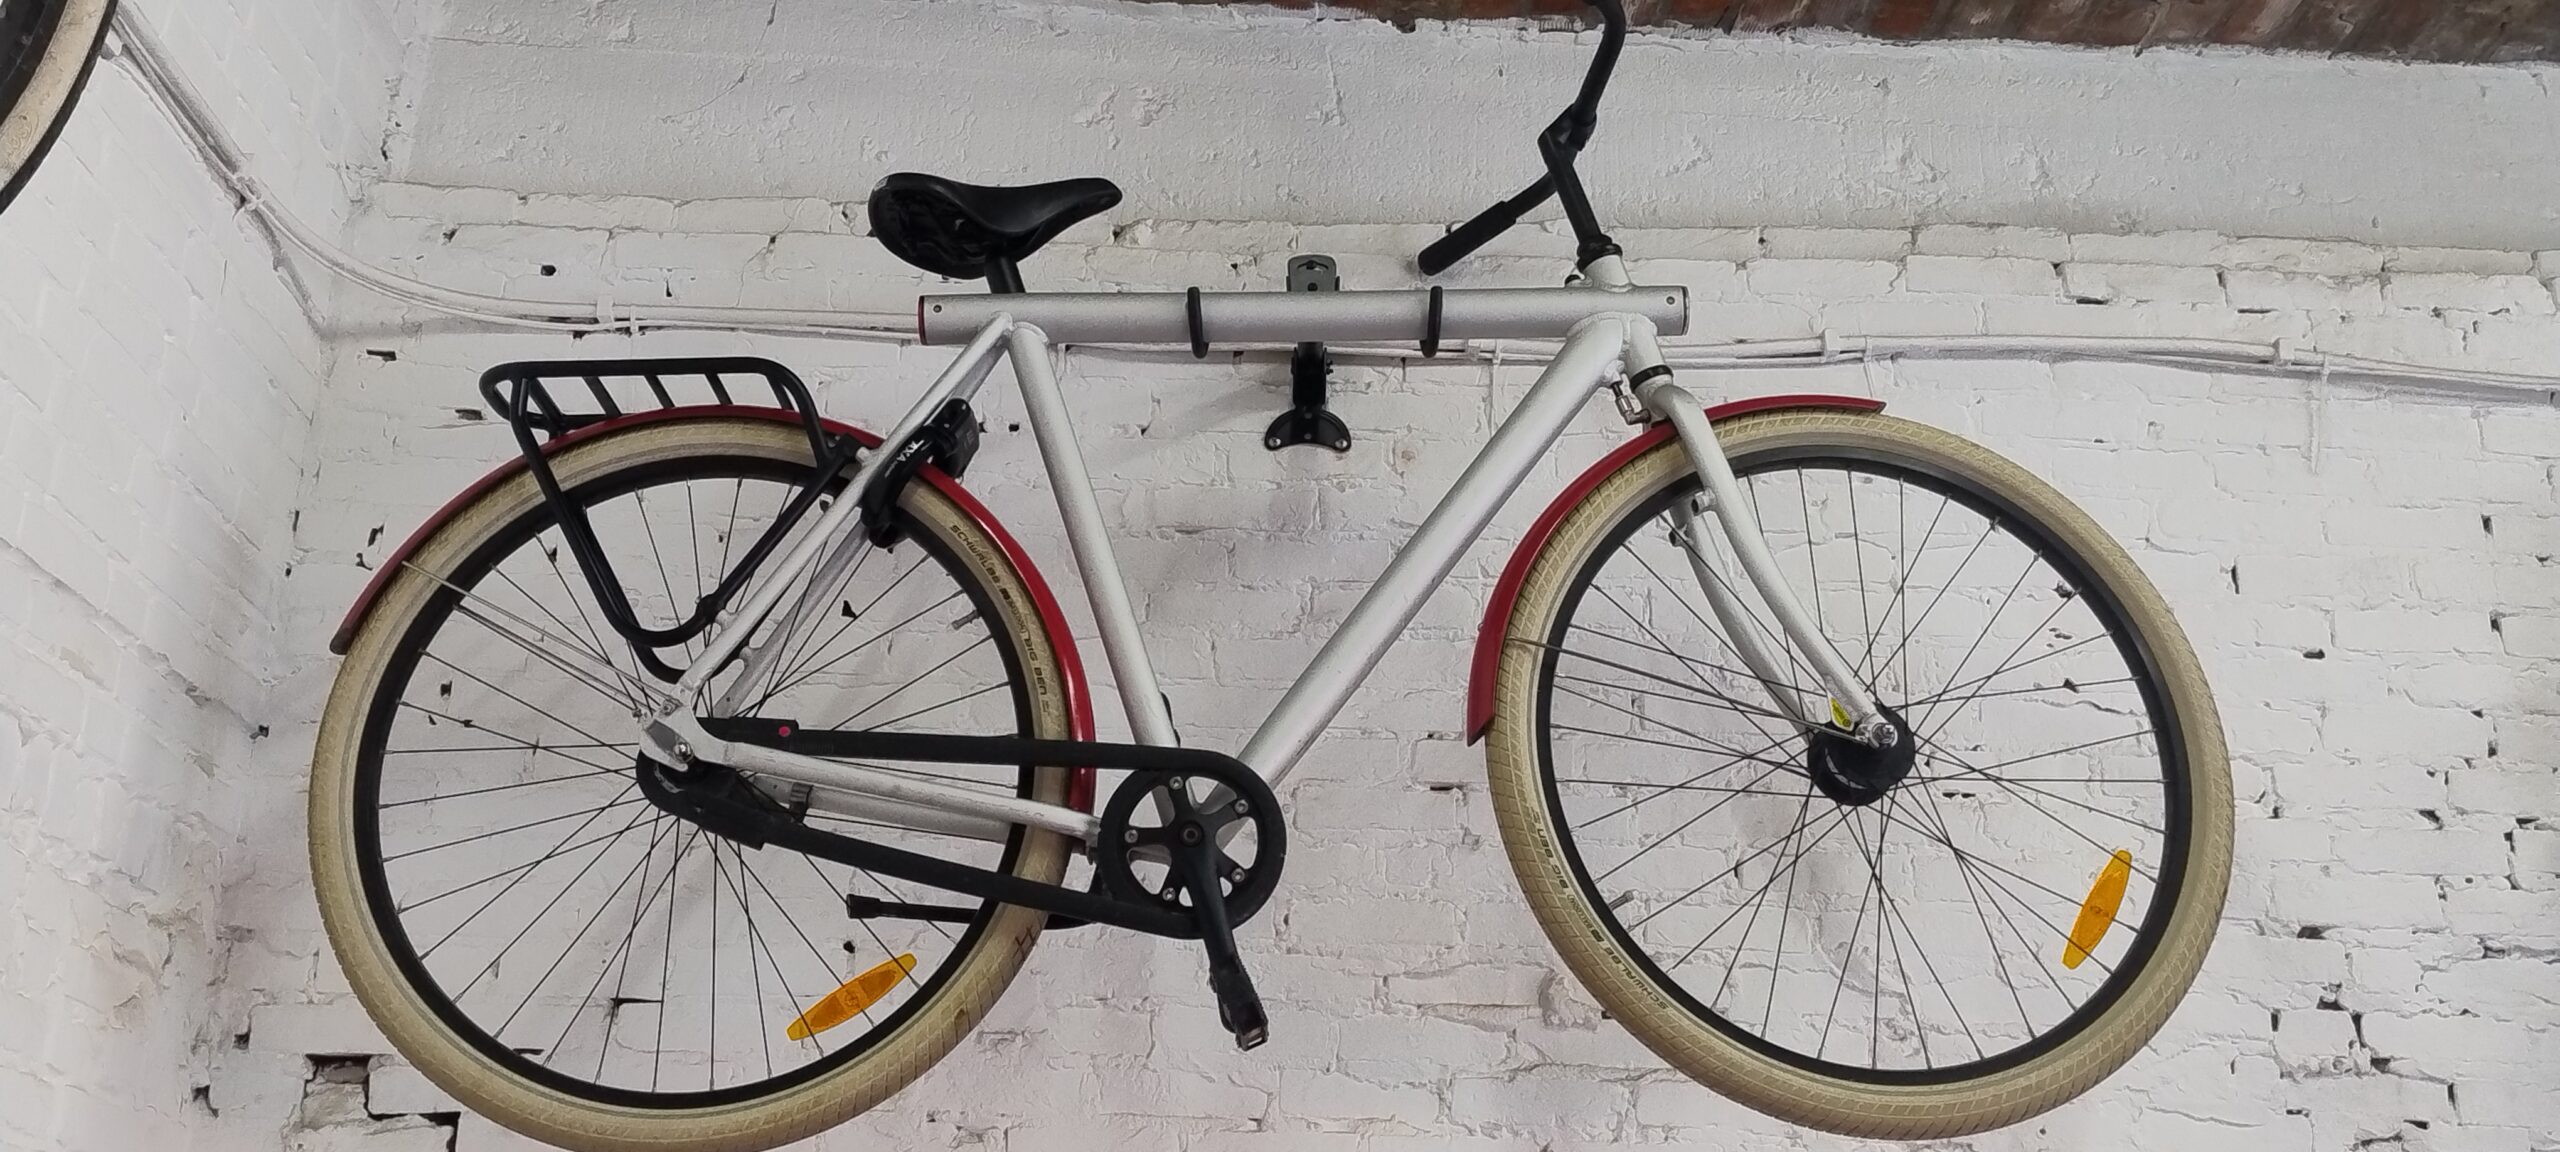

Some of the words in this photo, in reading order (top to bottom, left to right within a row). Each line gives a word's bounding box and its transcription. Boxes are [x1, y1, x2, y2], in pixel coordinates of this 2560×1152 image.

[896, 440, 925, 461] AXA
[950, 525, 1000, 583] SCHWALBE
[1024, 638, 1038, 661] BIG
[1034, 667, 1048, 696] BEN
[1537, 828, 1554, 858] BEN
[1551, 864, 1569, 889] BIG
[1604, 947, 1669, 1010] SCHWALBE
